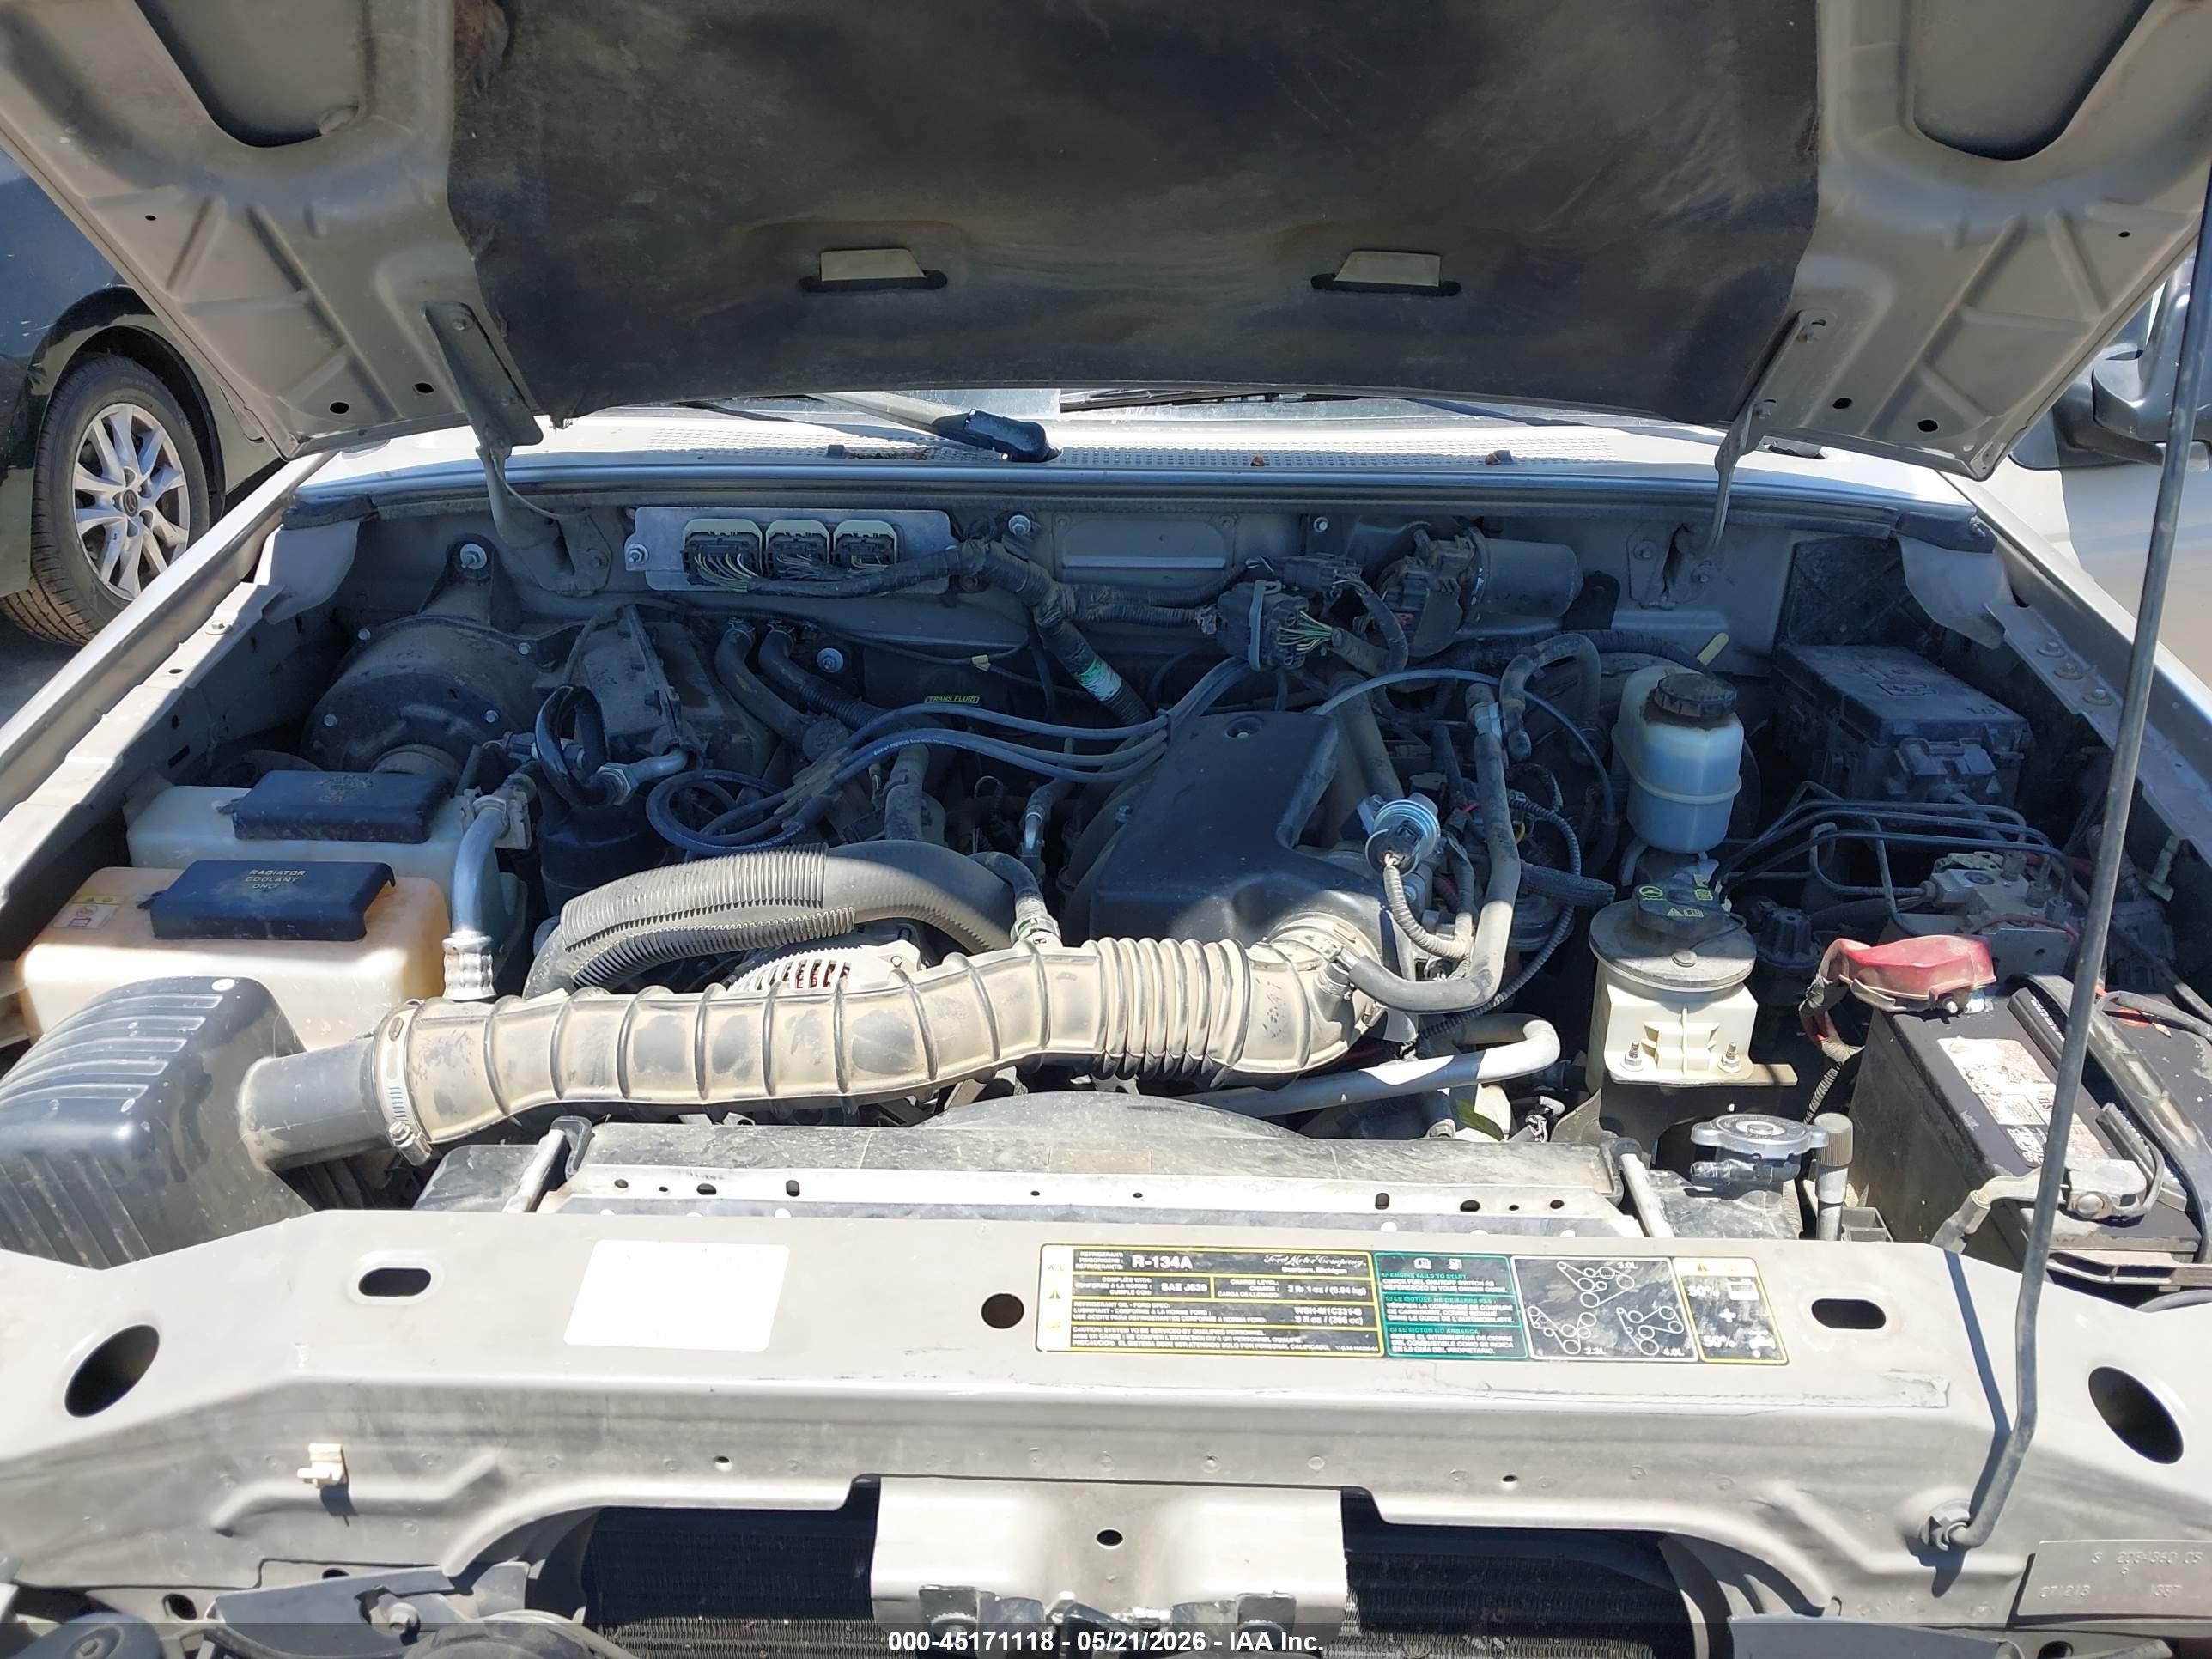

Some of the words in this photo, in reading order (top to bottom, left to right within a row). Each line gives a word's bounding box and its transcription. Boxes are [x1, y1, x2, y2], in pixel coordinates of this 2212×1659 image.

[1132, 1255, 1193, 1269] R-134A
[1618, 1261, 1638, 1270] 3.0L
[1161, 1282, 1182, 1291] SAE
[1704, 1335, 1735, 1348] 50%
